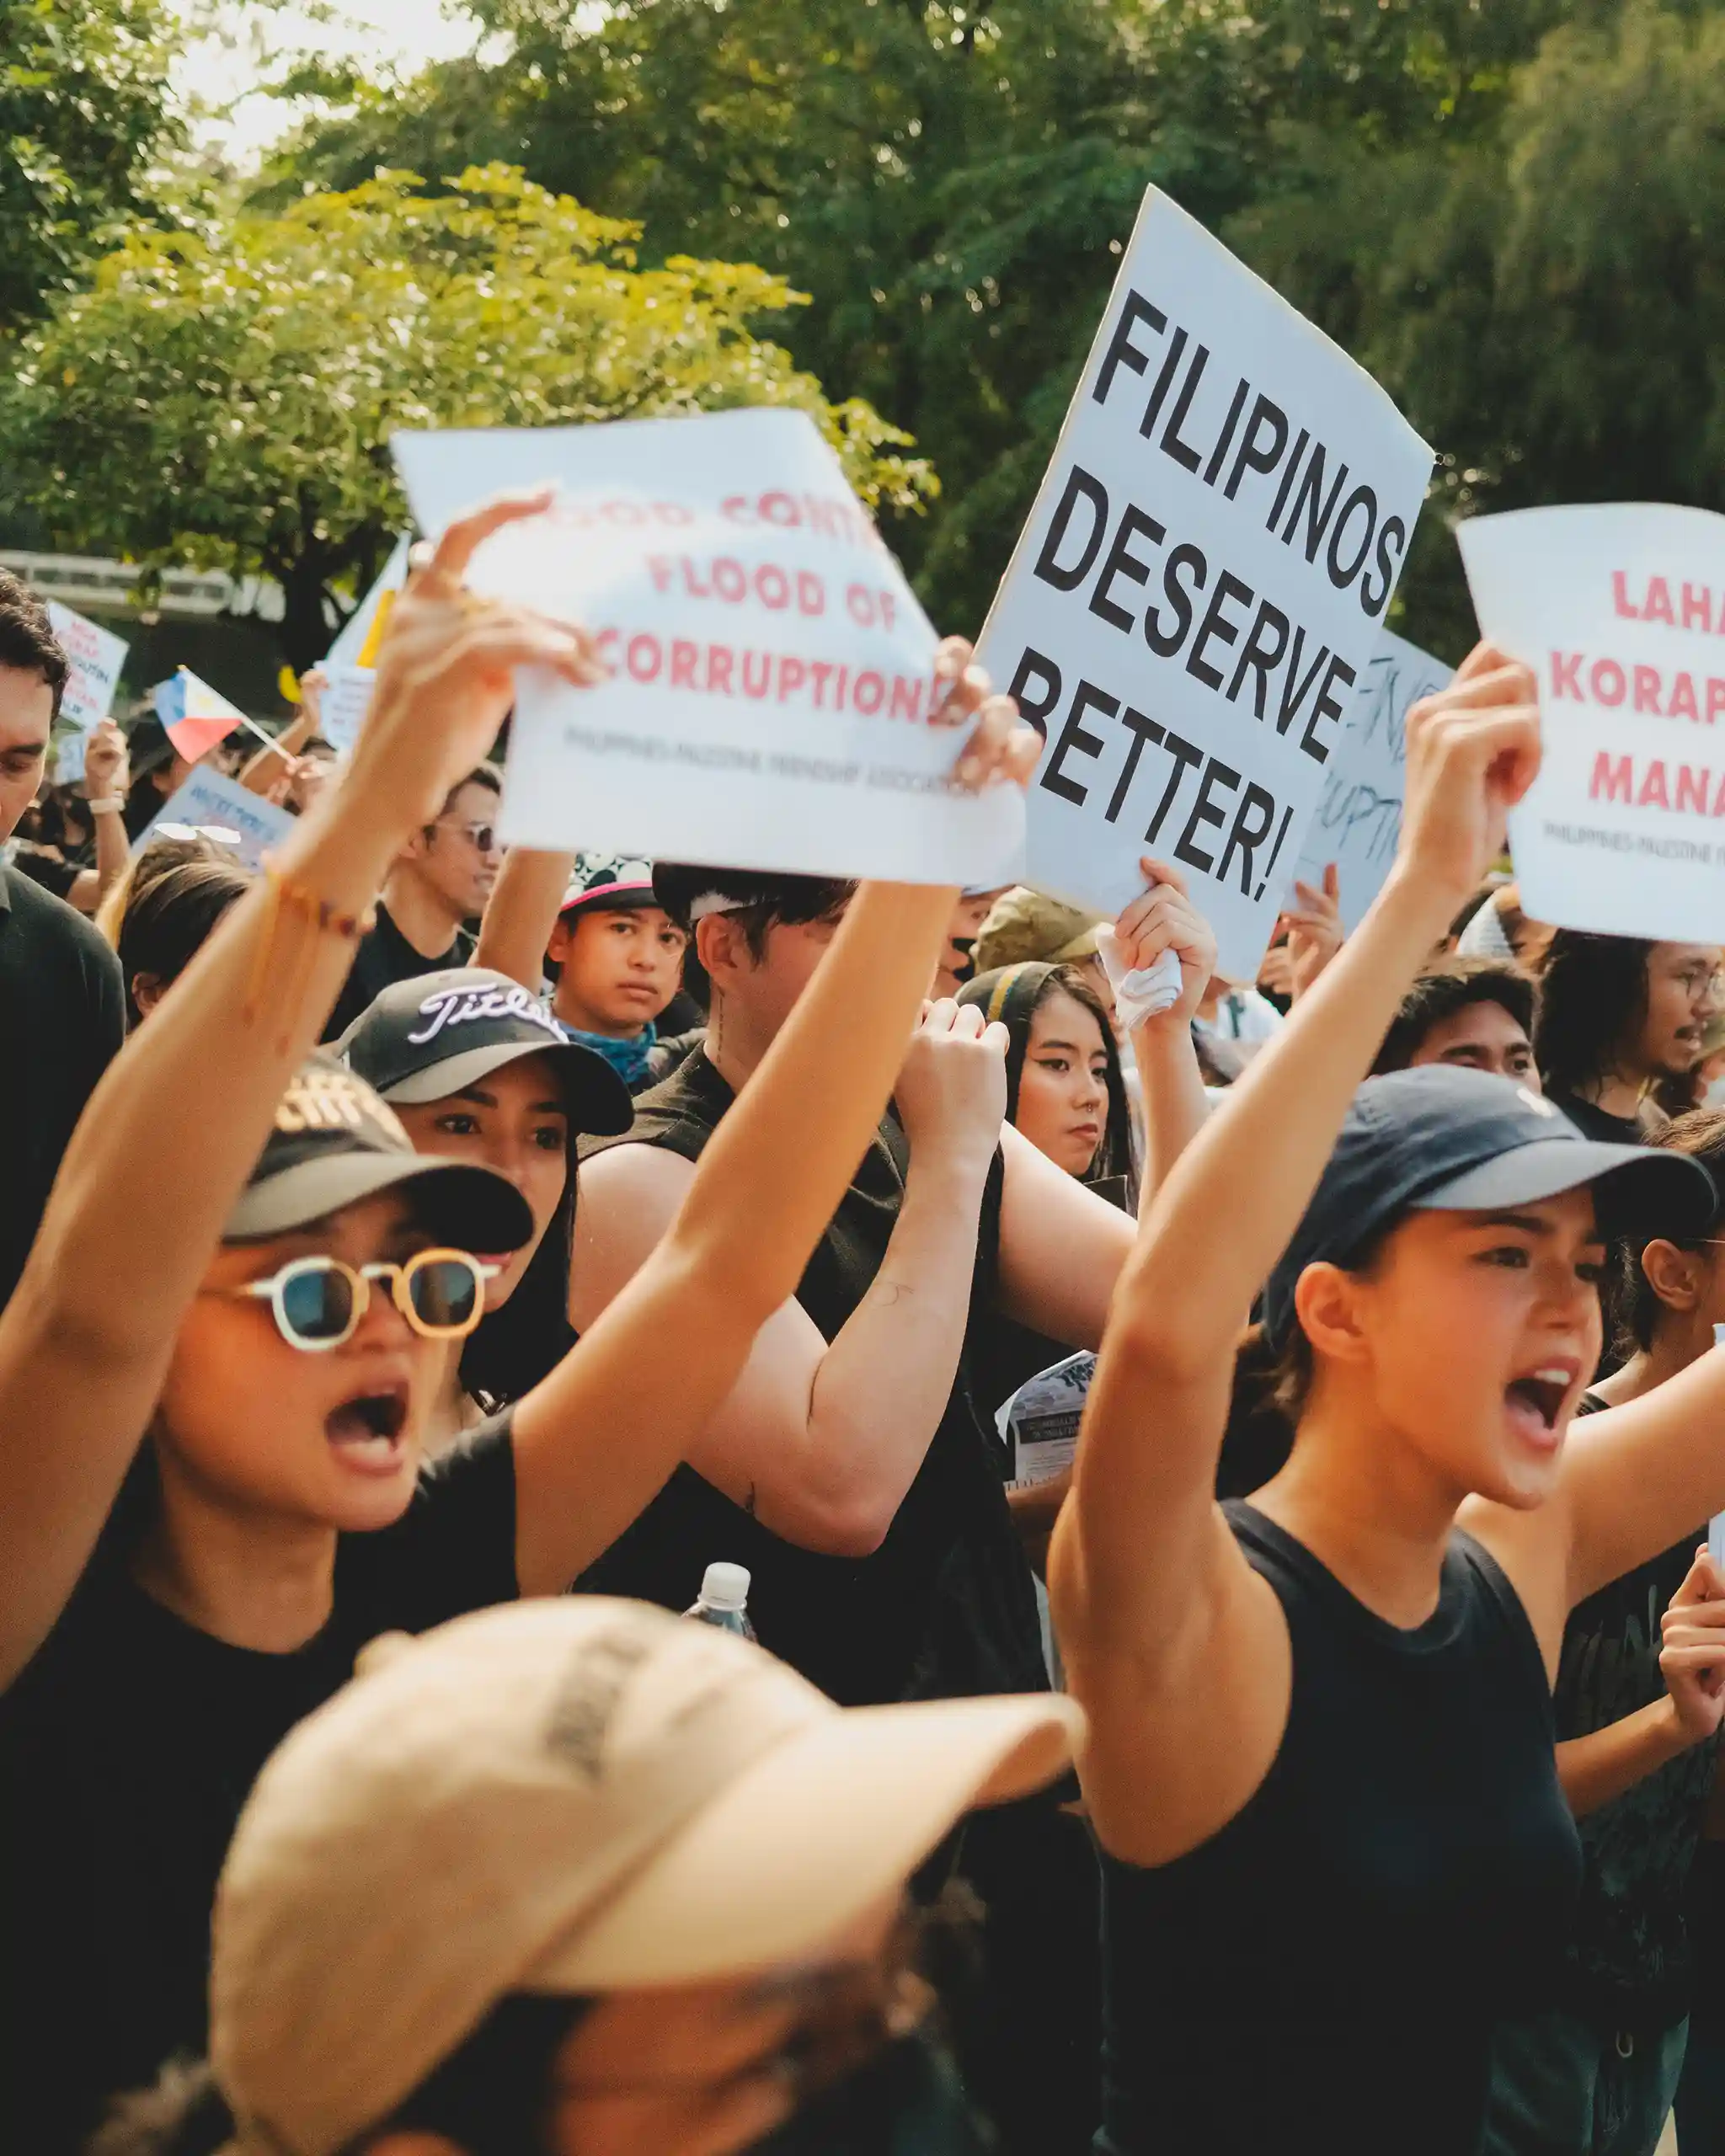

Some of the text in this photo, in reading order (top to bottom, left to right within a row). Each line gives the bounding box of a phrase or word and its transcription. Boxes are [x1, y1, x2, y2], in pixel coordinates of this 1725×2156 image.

[1092, 289, 1406, 616] FILIPINOS
[845, 582, 897, 633] OF
[1033, 465, 1357, 765] DESERVE
[1610, 570, 1725, 636] LAH
[1007, 647, 1295, 903] BETTER!
